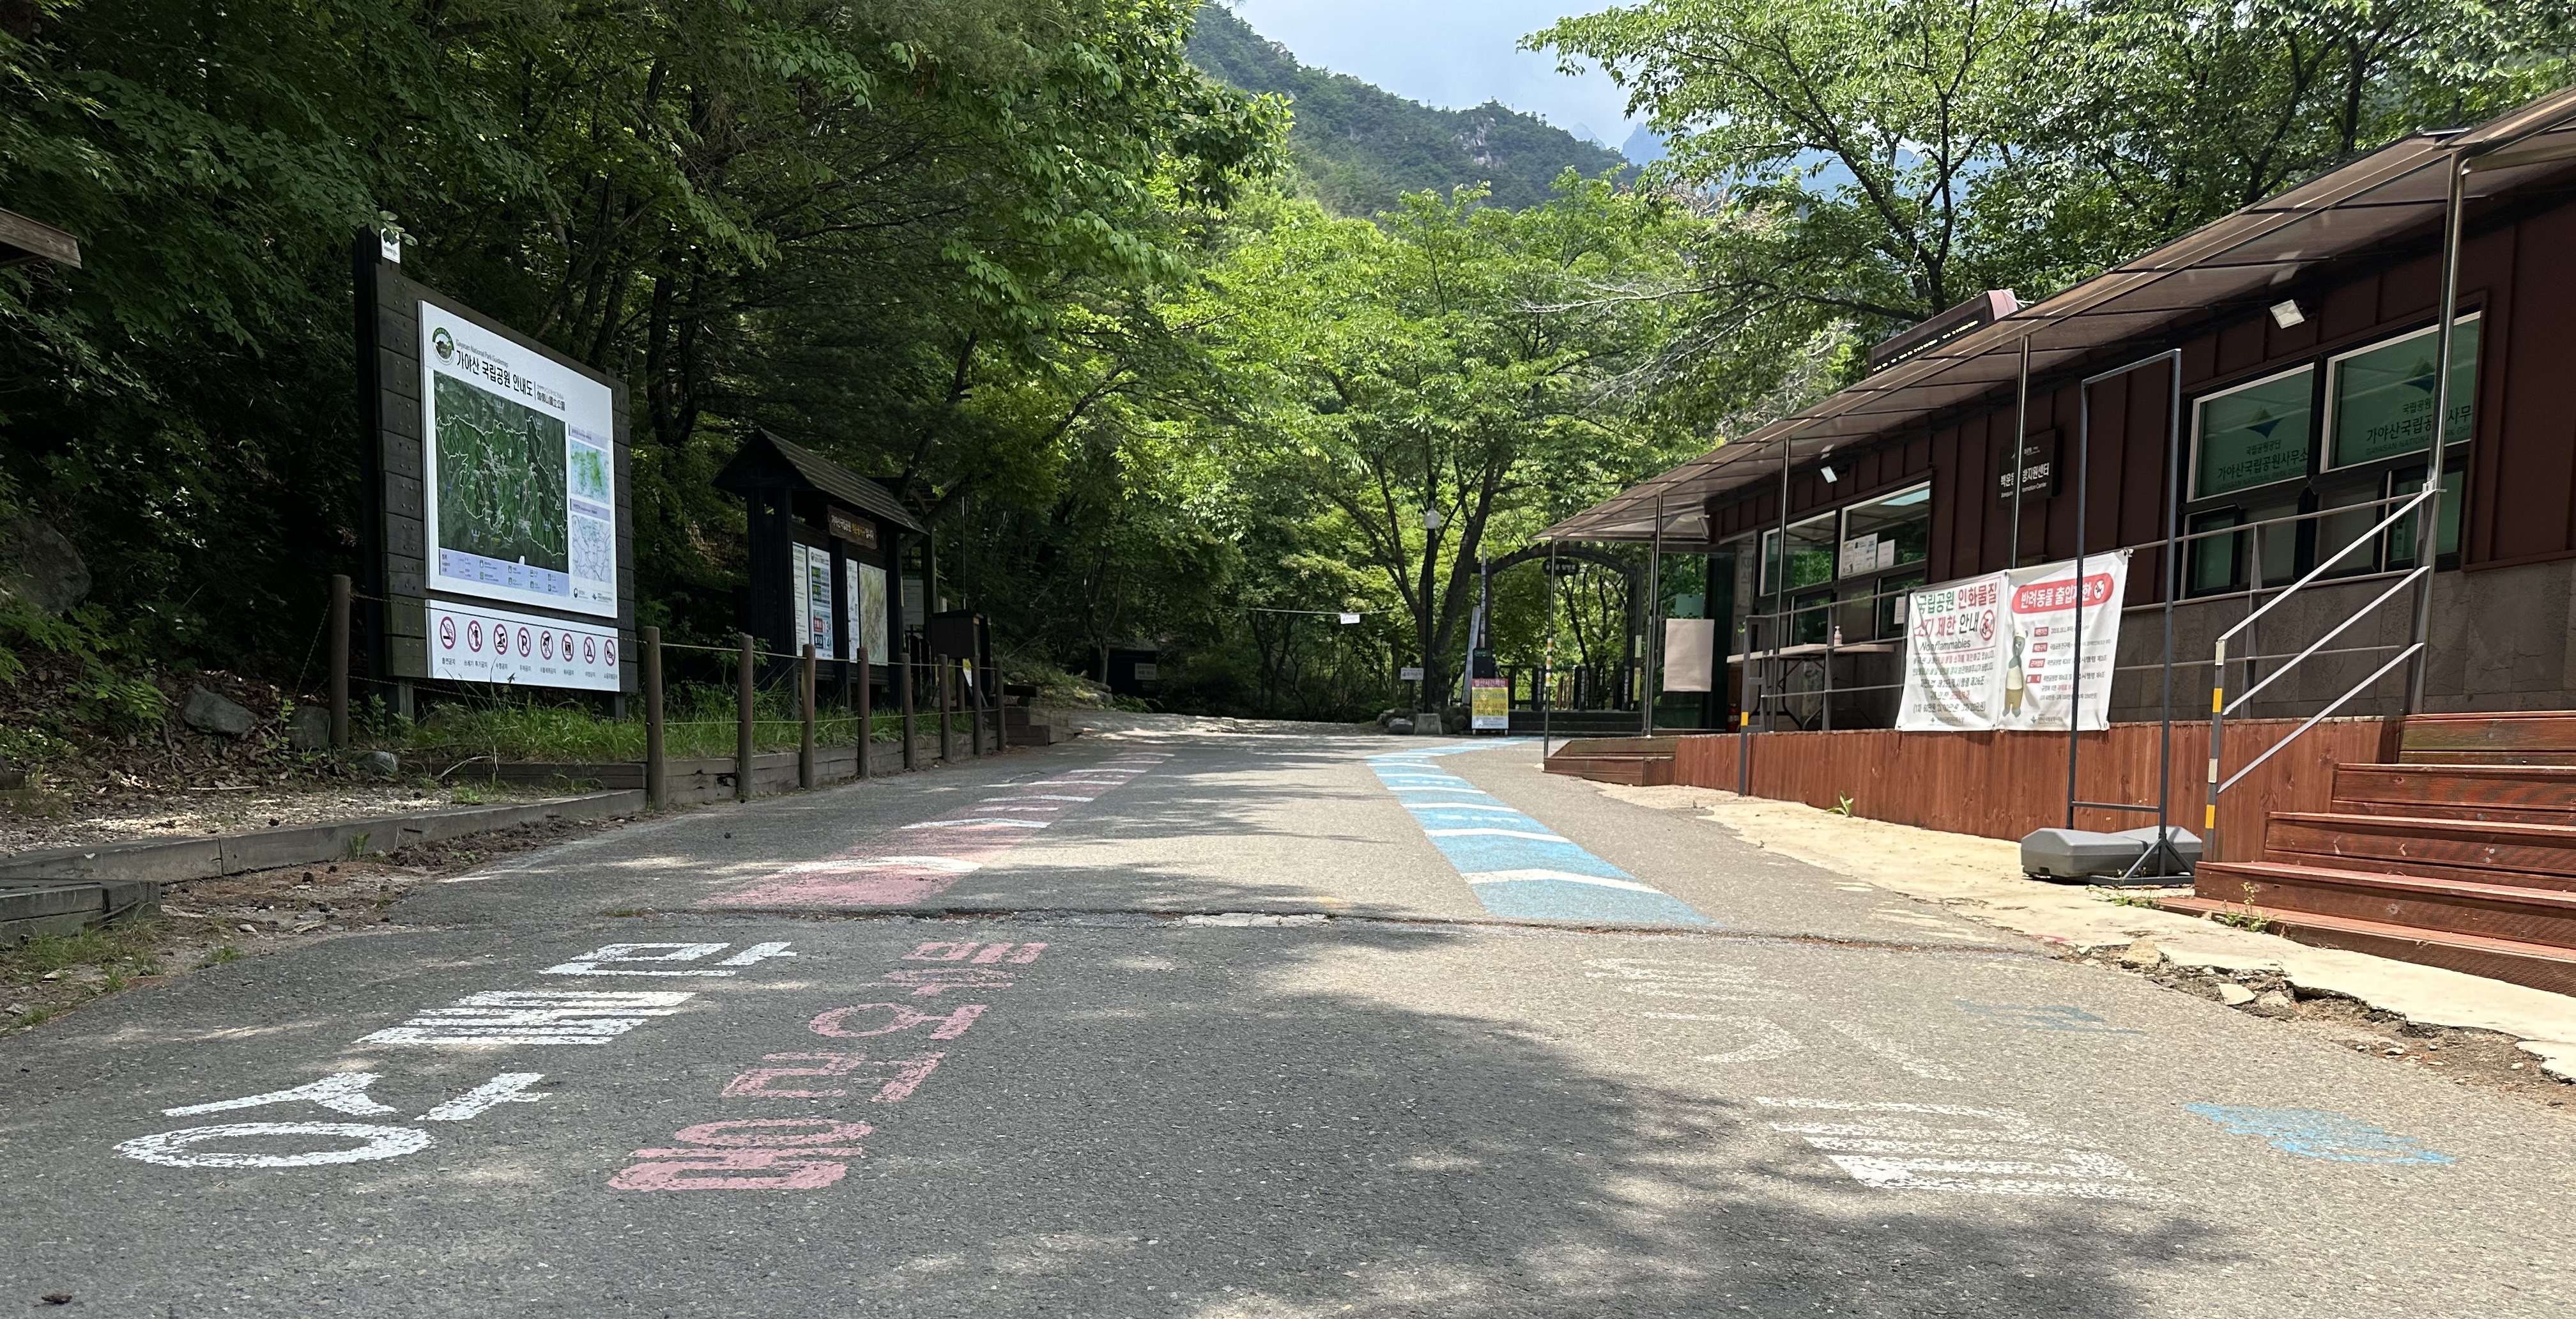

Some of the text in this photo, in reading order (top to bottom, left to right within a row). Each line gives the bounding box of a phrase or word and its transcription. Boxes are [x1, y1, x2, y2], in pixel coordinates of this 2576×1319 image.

[457, 350, 479, 375] 가야산
[482, 360, 510, 388] 국립공원
[513, 374, 533, 396] 안내도
[2246, 440, 2281, 455] 국립공원공단
[2399, 435, 2430, 446] NATIONA
[2218, 447, 2308, 481] 가야산국립공원사무소
[1918, 582, 1997, 614] 국립공원 인화물질
[2021, 587, 2053, 609] 반려동물
[1936, 615, 1956, 636] 제한
[1959, 612, 1980, 634] 안내
[1919, 638, 1971, 651] Nonflammables
[112, 941, 797, 1168] 만물상
